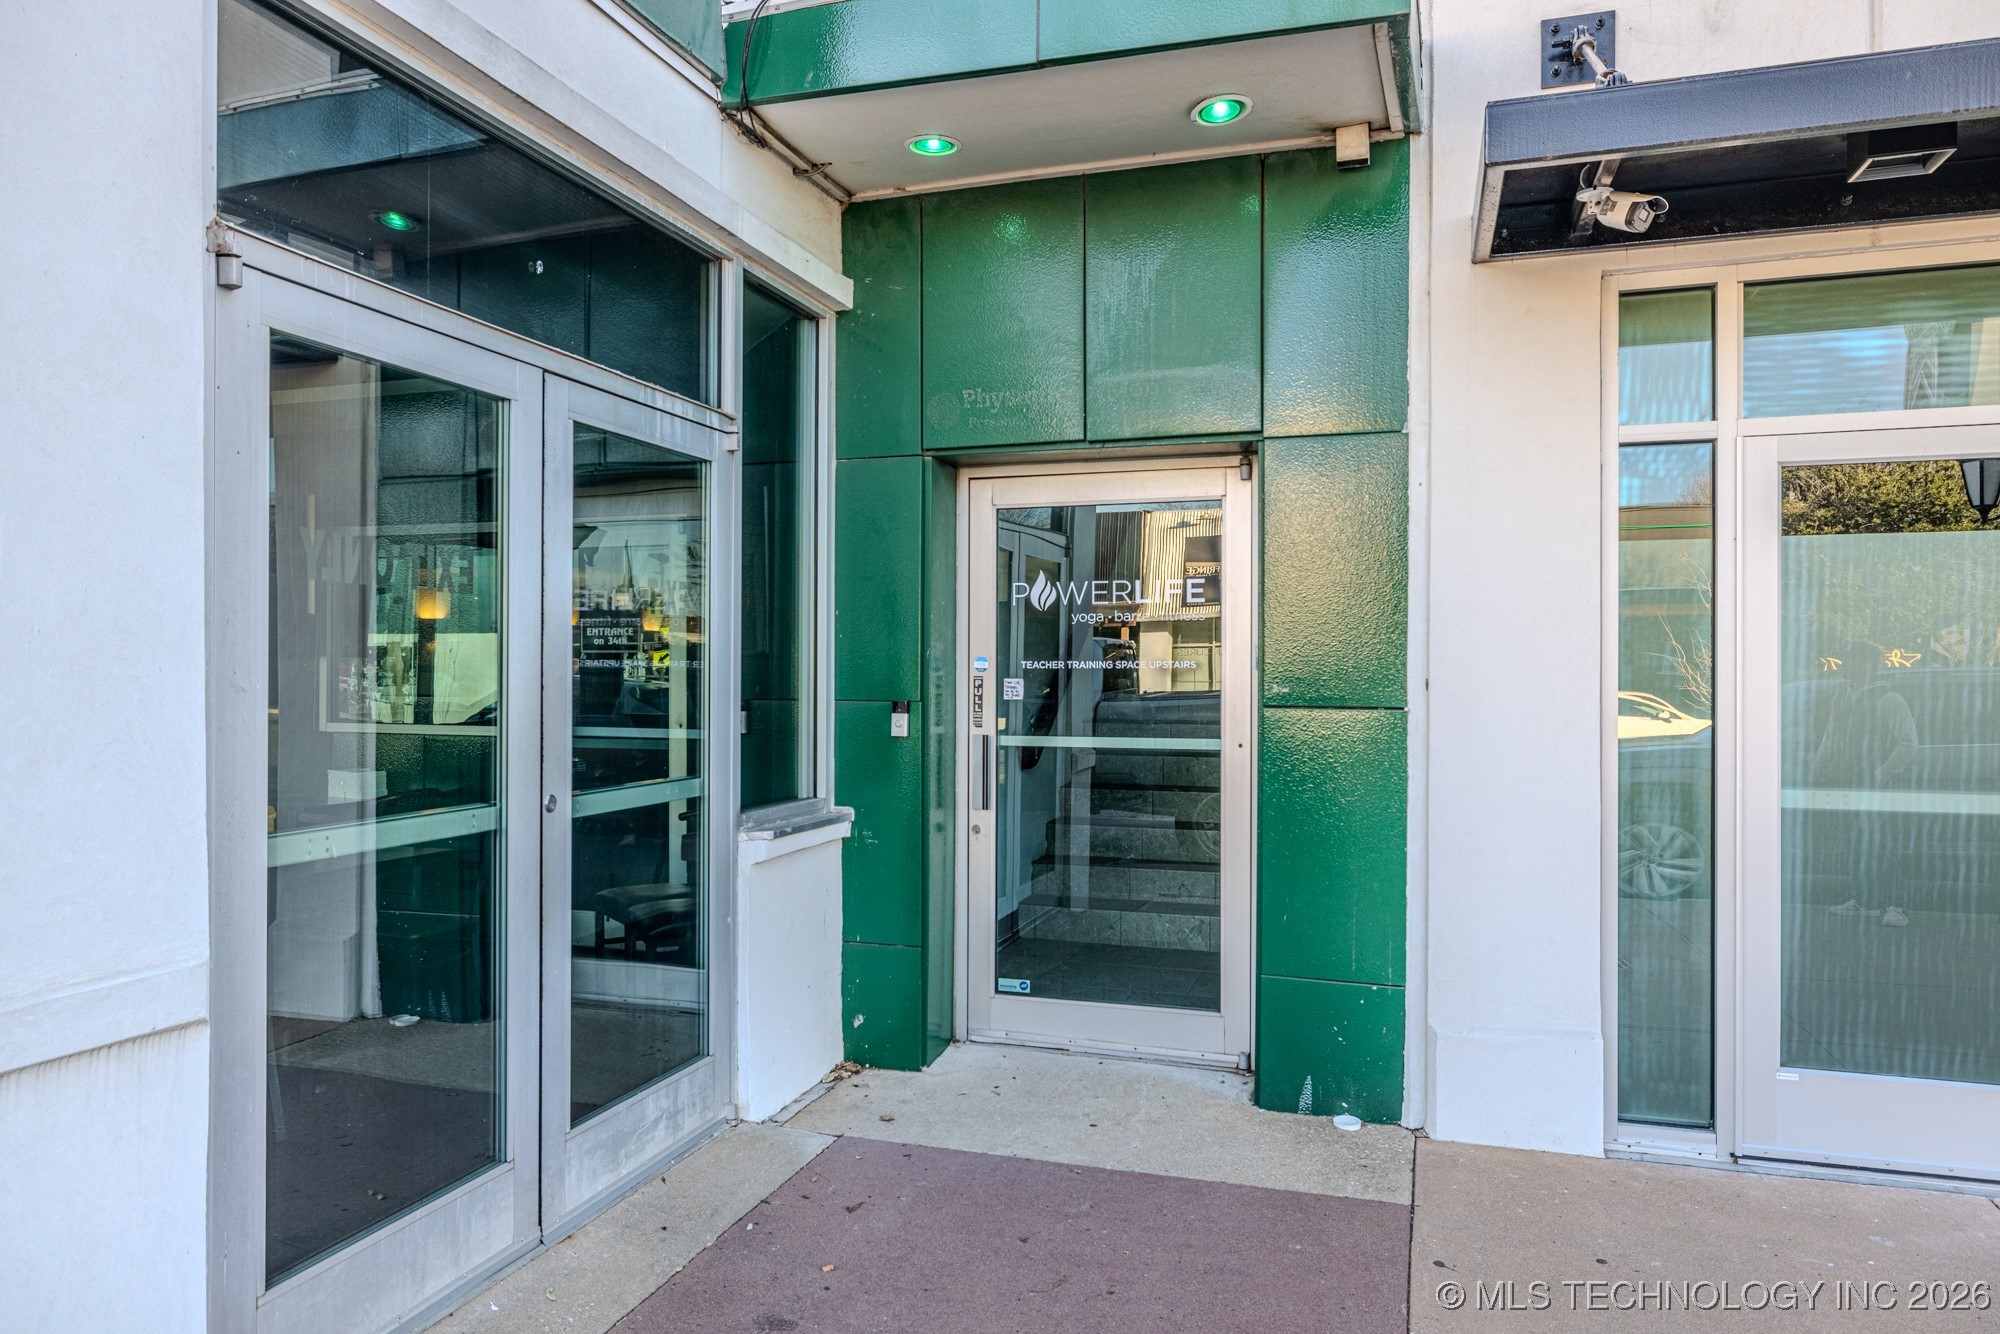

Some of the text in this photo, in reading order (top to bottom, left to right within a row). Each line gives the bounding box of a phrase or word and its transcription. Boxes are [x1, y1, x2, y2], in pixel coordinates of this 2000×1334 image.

[1071, 610, 1104, 624] yoga
[1114, 610, 1149, 622] barre
[586, 627, 634, 636] ENTRANCE
[607, 636, 627, 645] 34th
[1021, 660, 1197, 669] TEACHER TRAINING SPACE UPSTAIRS
[974, 679, 983, 712] PULL
